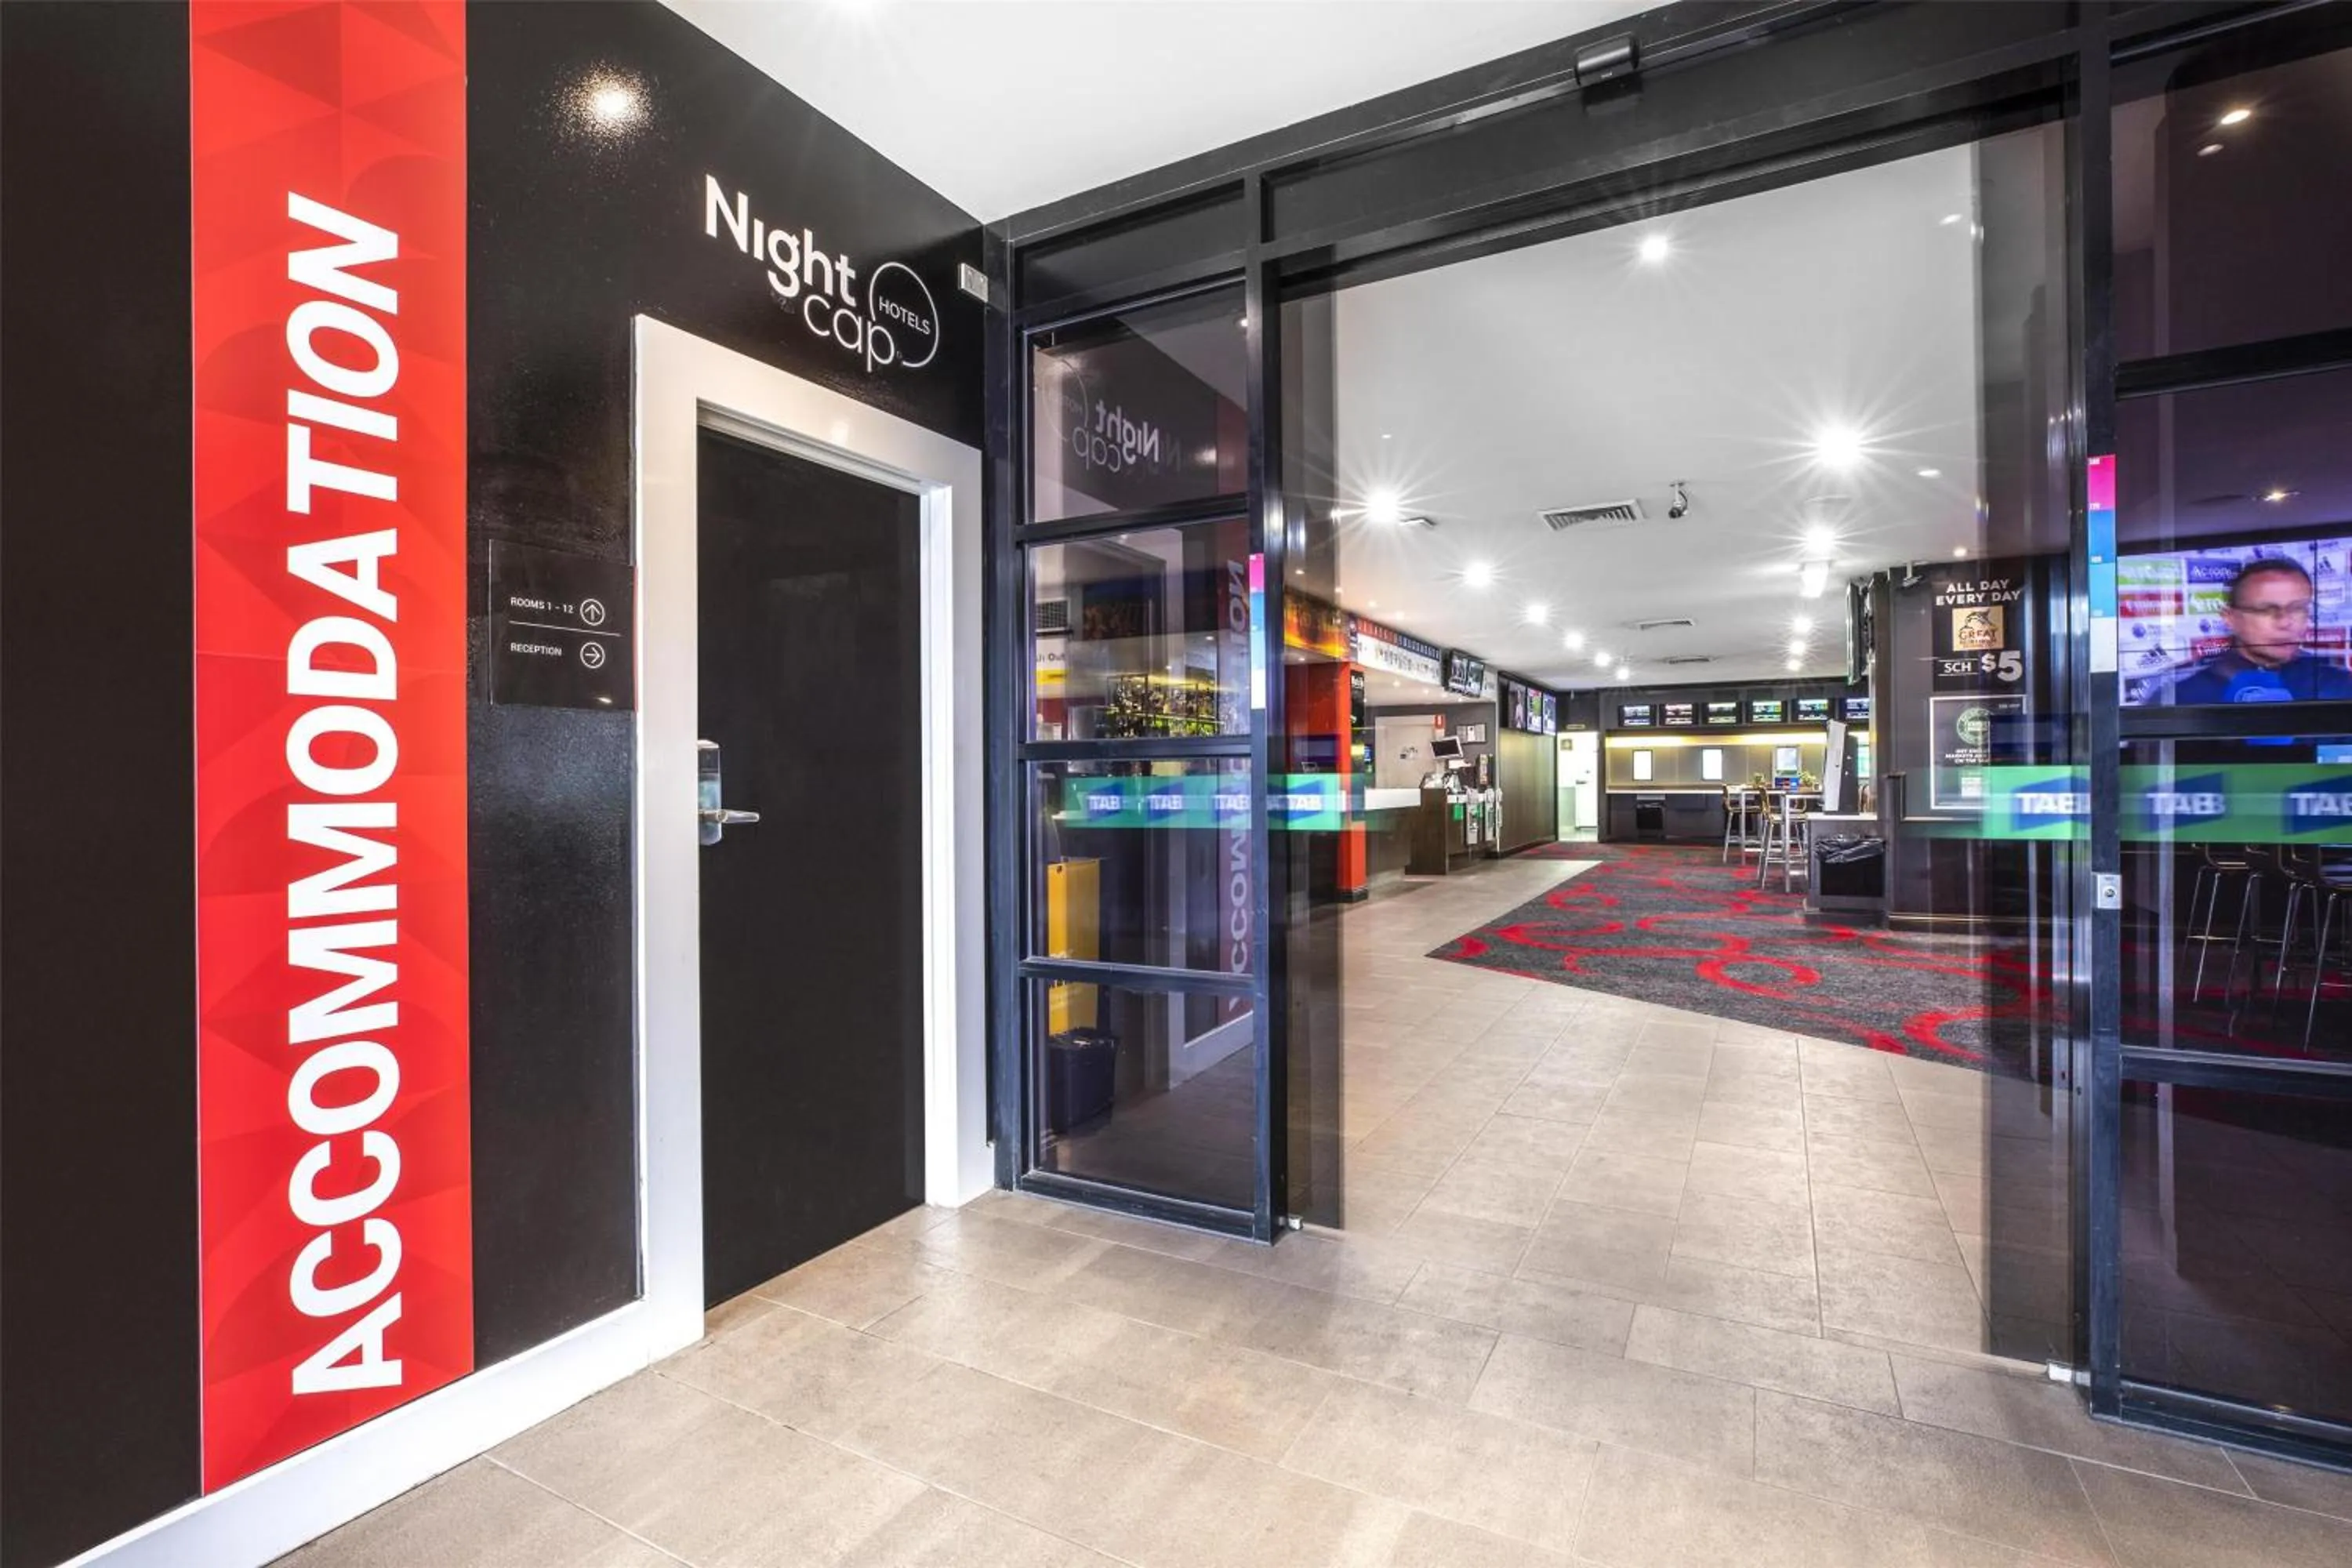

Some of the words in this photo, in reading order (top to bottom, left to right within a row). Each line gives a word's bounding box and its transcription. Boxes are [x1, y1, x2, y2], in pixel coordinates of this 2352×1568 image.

[706, 173, 857, 307] Night
[878, 296, 931, 336] HOTELS
[804, 294, 895, 372] cap
[1946, 583, 1975, 593] ALL
[1980, 579, 2010, 590] DAY
[510, 597, 545, 609] ROOMS
[563, 604, 574, 614] 12
[1936, 593, 1985, 606] EVERY
[1991, 590, 2020, 601] DAY
[510, 642, 562, 656] RECEPTION
[1944, 662, 1972, 673] SCH
[1981, 650, 2023, 682] $5
[287, 192, 403, 1396] ACCOMMODATION
[1087, 794, 1120, 811] TAB
[1147, 794, 1182, 811] TAB
[1214, 794, 1250, 811] TAB
[2016, 793, 2087, 815] TAB
[2146, 793, 2225, 815] TAB
